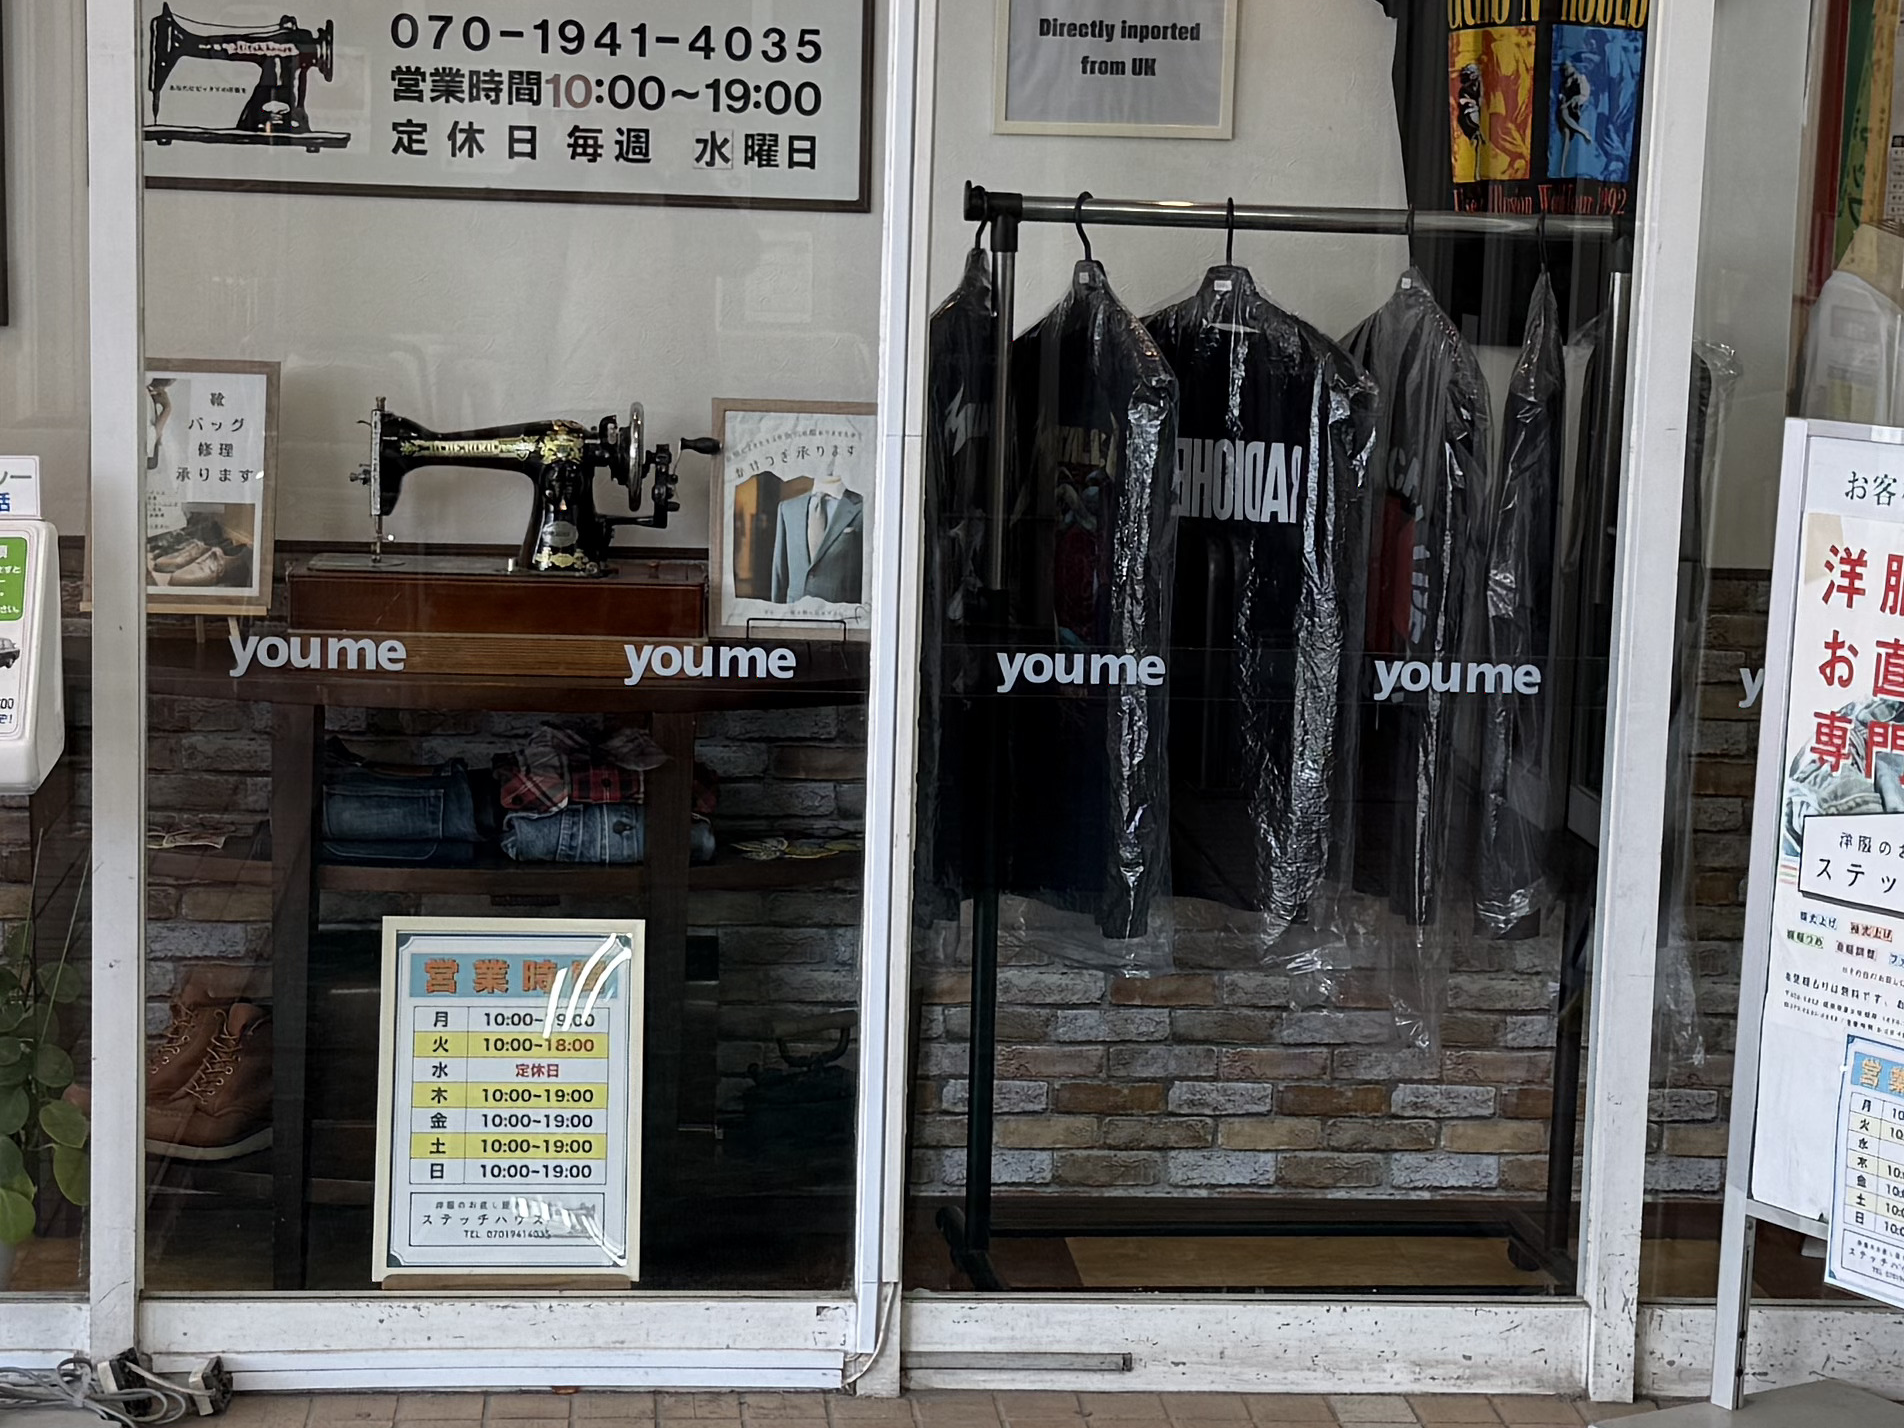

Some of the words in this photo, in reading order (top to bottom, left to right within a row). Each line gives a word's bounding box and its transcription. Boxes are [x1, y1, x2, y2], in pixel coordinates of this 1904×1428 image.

[390, 14, 823, 63] 070-1941-4035
[1039, 17, 1115, 42] Directly
[1120, 19, 1201, 45] inported
[1081, 54, 1126, 76] from
[1131, 56, 1157, 77] UK
[391, 120, 540, 160] 定休日
[567, 126, 652, 165] 毎週
[694, 129, 818, 171] 水曜日
[210, 392, 225, 407] 靴
[188, 417, 245, 432] バッグ
[198, 442, 233, 458] 修理
[176, 467, 254, 483] 承ります
[228, 633, 407, 678] youme
[623, 642, 797, 686] youme
[996, 650, 1167, 694] youme
[1374, 659, 1543, 701] youme
[434, 1011, 449, 1028] 月
[432, 1037, 449, 1053] 火
[483, 1037, 594, 1053] 10:00~18:00
[431, 1062, 449, 1078] 水
[515, 1063, 560, 1079] 定休日
[431, 1087, 448, 1103] 木
[482, 1088, 594, 1103] 10:00~19:00
[430, 1112, 447, 1129] 金
[481, 1114, 593, 1129] 10:00~19:00
[430, 1138, 447, 1155] 土
[480, 1139, 593, 1154] 10:00~19:00
[430, 1163, 445, 1179] 日
[479, 1164, 592, 1179] 10:00~19:00
